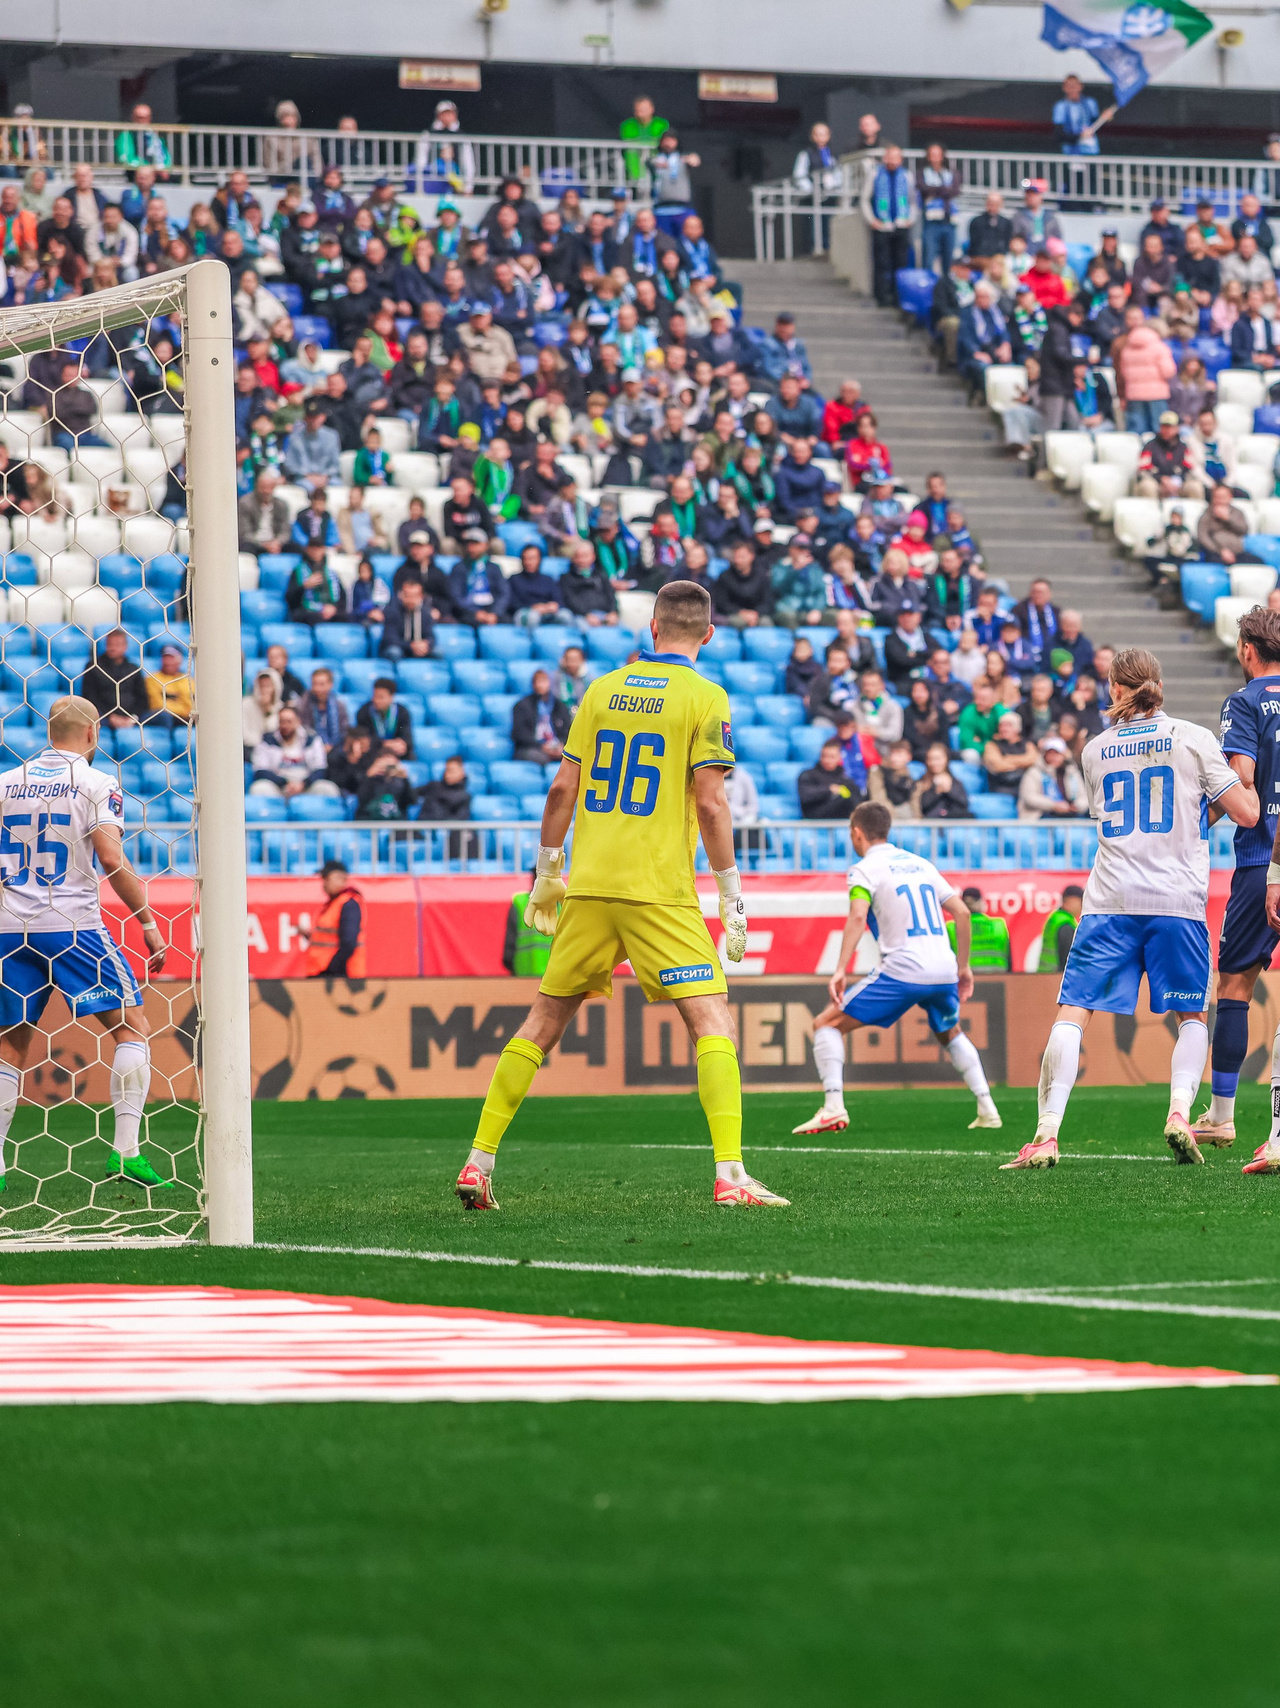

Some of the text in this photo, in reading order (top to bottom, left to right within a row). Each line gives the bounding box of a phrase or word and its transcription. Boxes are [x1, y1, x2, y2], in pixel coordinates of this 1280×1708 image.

[626, 677, 668, 687] БЕТСИТИ
[608, 694, 665, 714] ОБУХОВ
[1118, 725, 1158, 735] БЕТСИТИ
[1101, 738, 1172, 760] КОКШАРОВ
[28, 766, 68, 777] БЕТСИТИ
[585, 729, 666, 817] 96
[5, 783, 79, 800] ТОДОРОВИЧ
[1102, 765, 1174, 838] 90
[0, 813, 71, 886] 55
[896, 884, 943, 936] 10
[661, 968, 712, 982] БЕТСИТИ
[1163, 991, 1203, 1000] БЕТСИТИ
